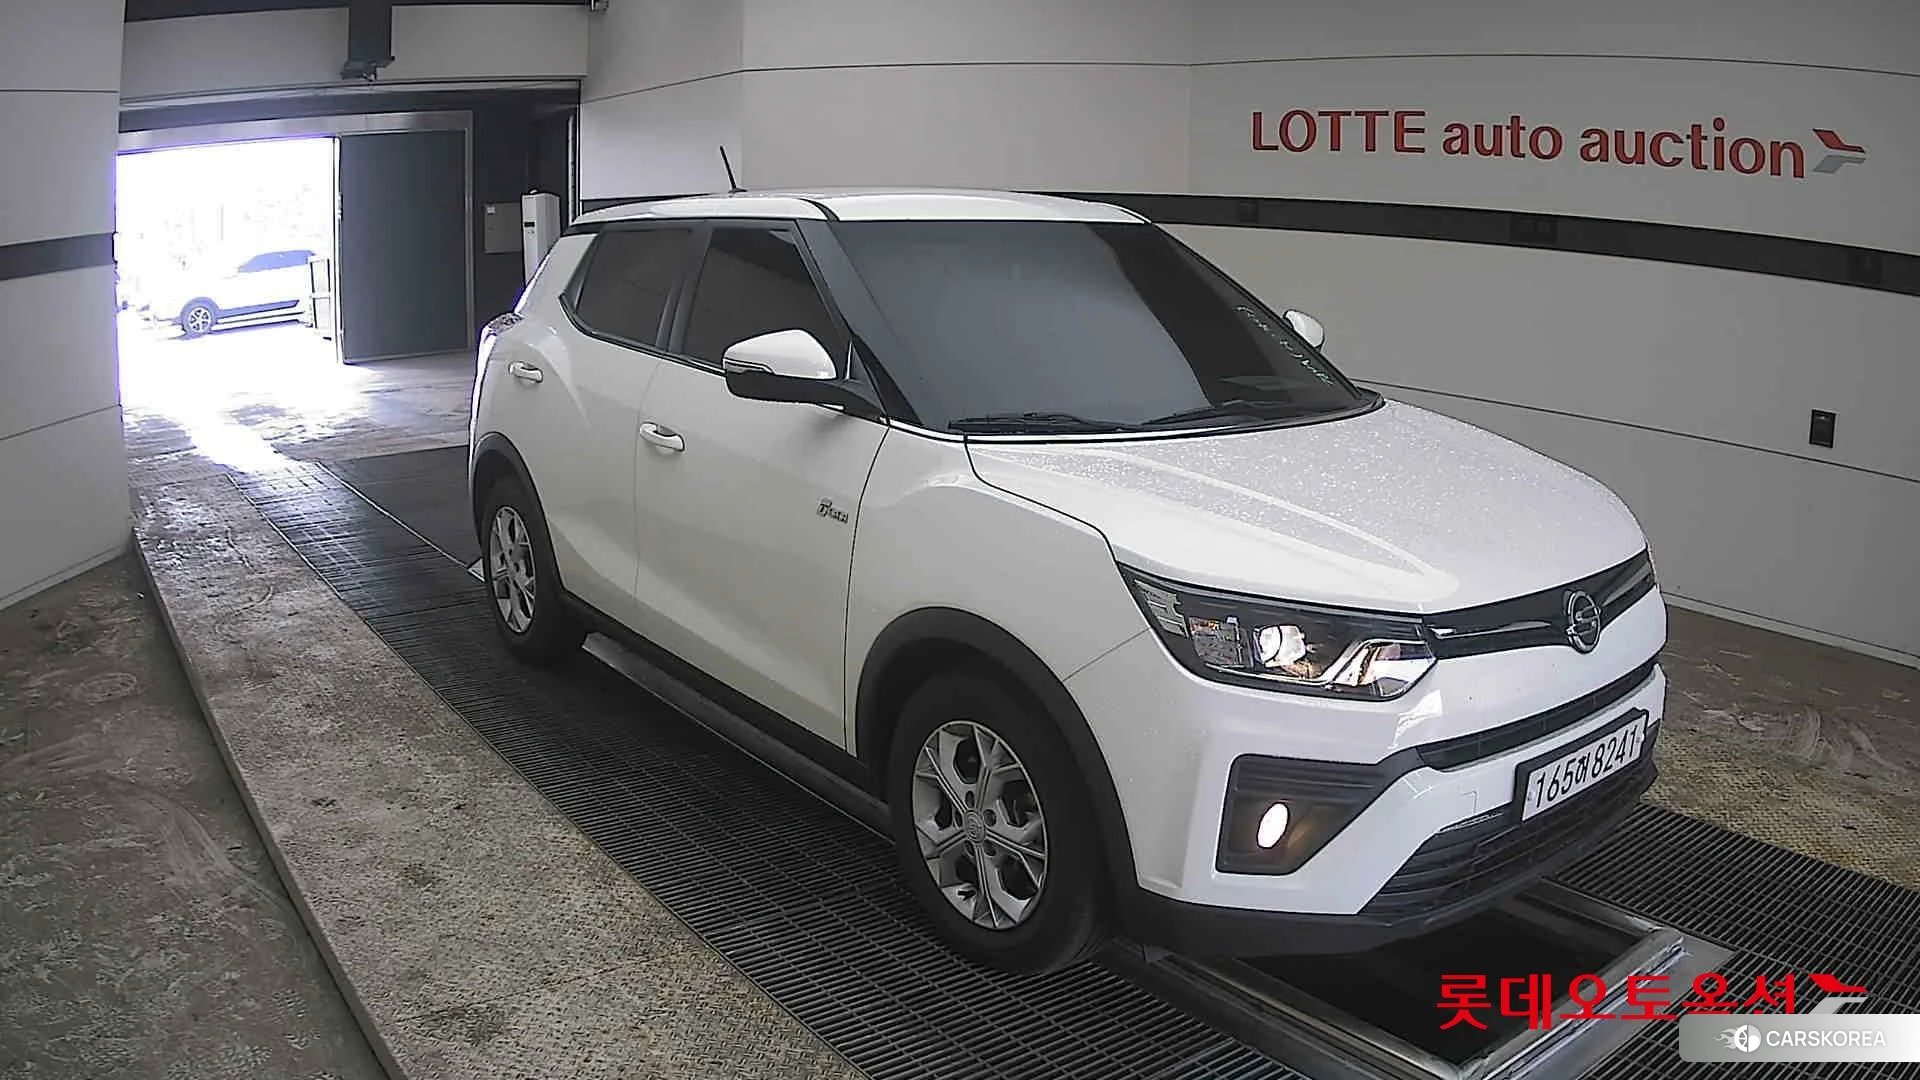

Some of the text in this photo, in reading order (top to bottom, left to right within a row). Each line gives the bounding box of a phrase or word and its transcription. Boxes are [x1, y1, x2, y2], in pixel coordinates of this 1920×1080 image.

[1252, 110, 1805, 178] LOTTE auto auction
